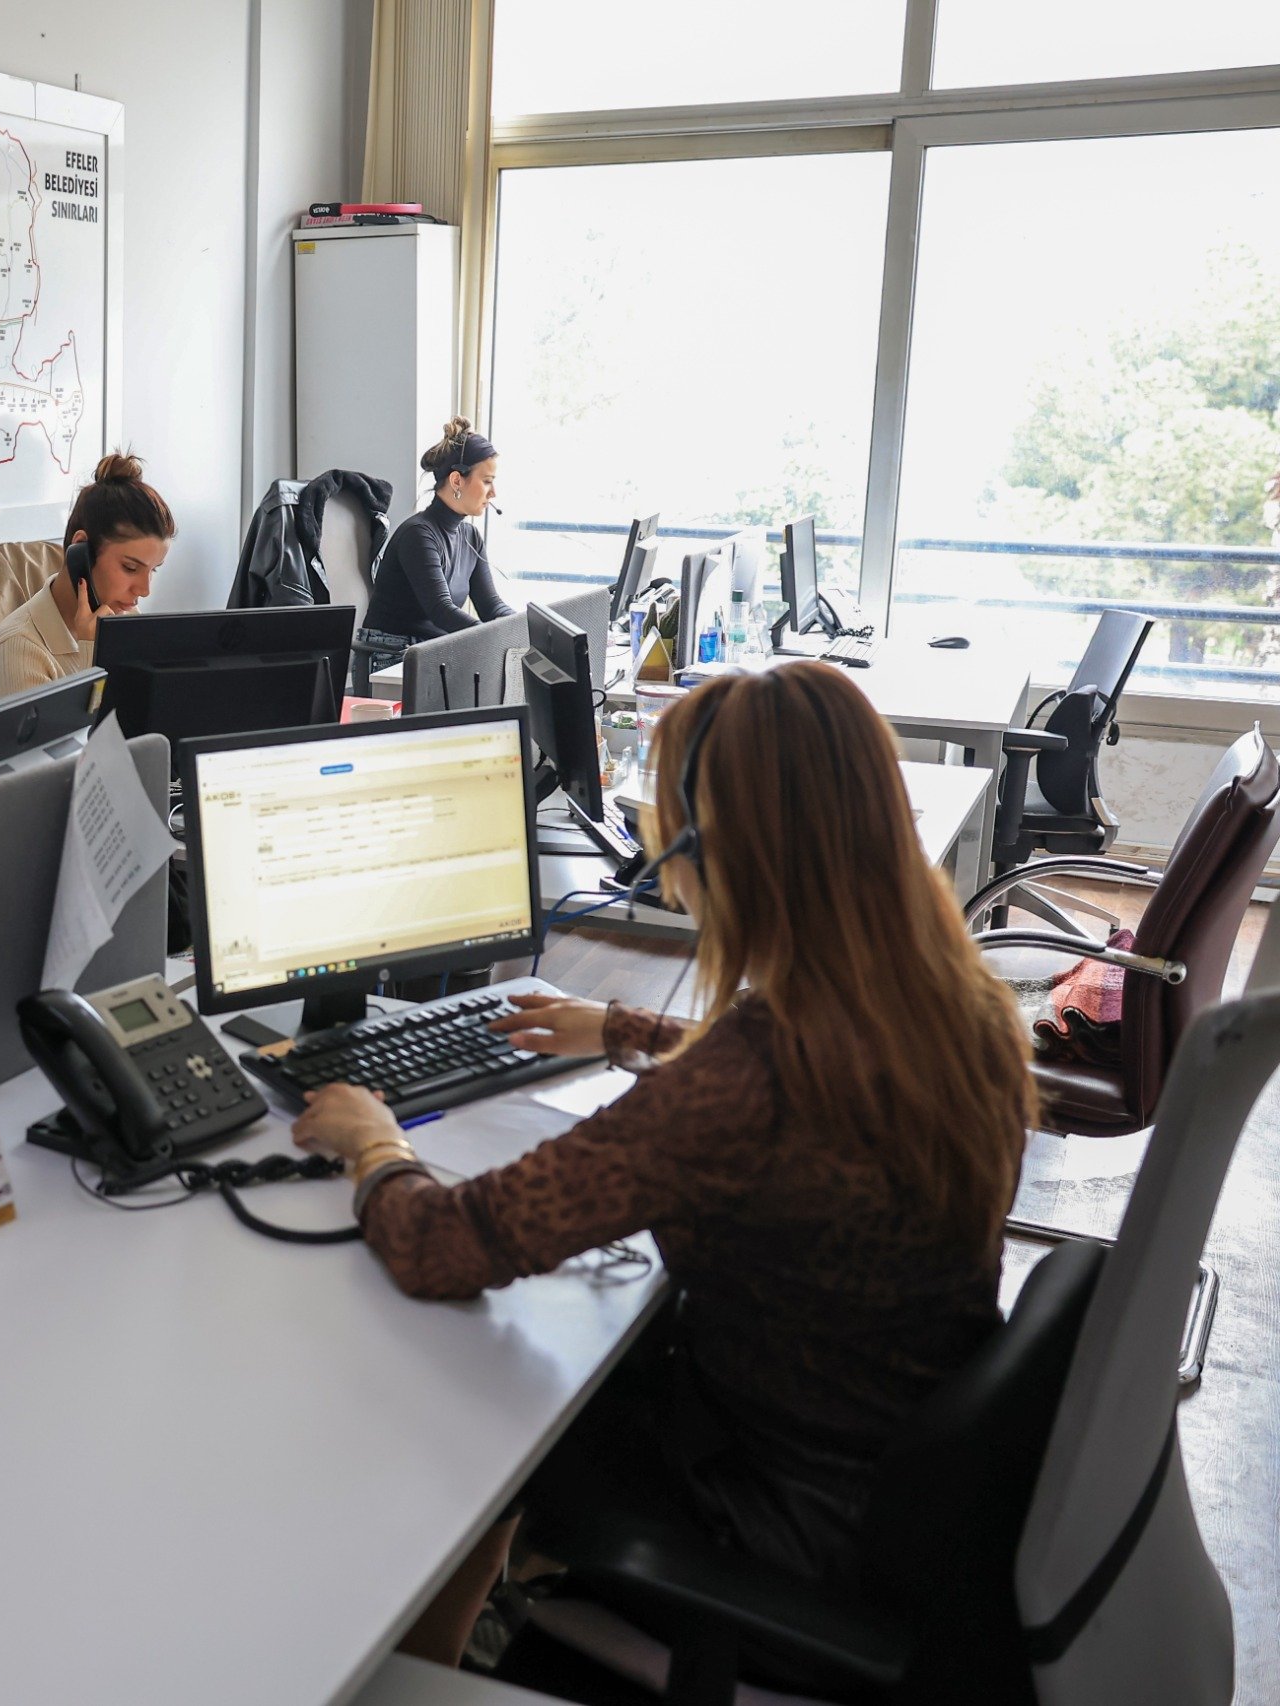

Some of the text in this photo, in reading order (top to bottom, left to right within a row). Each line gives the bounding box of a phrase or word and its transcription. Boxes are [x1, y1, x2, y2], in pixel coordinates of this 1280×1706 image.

[66, 150, 98, 173] EFELER
[45, 172, 98, 198] BELEDİYESİ
[51, 200, 98, 223] SINIRLARI
